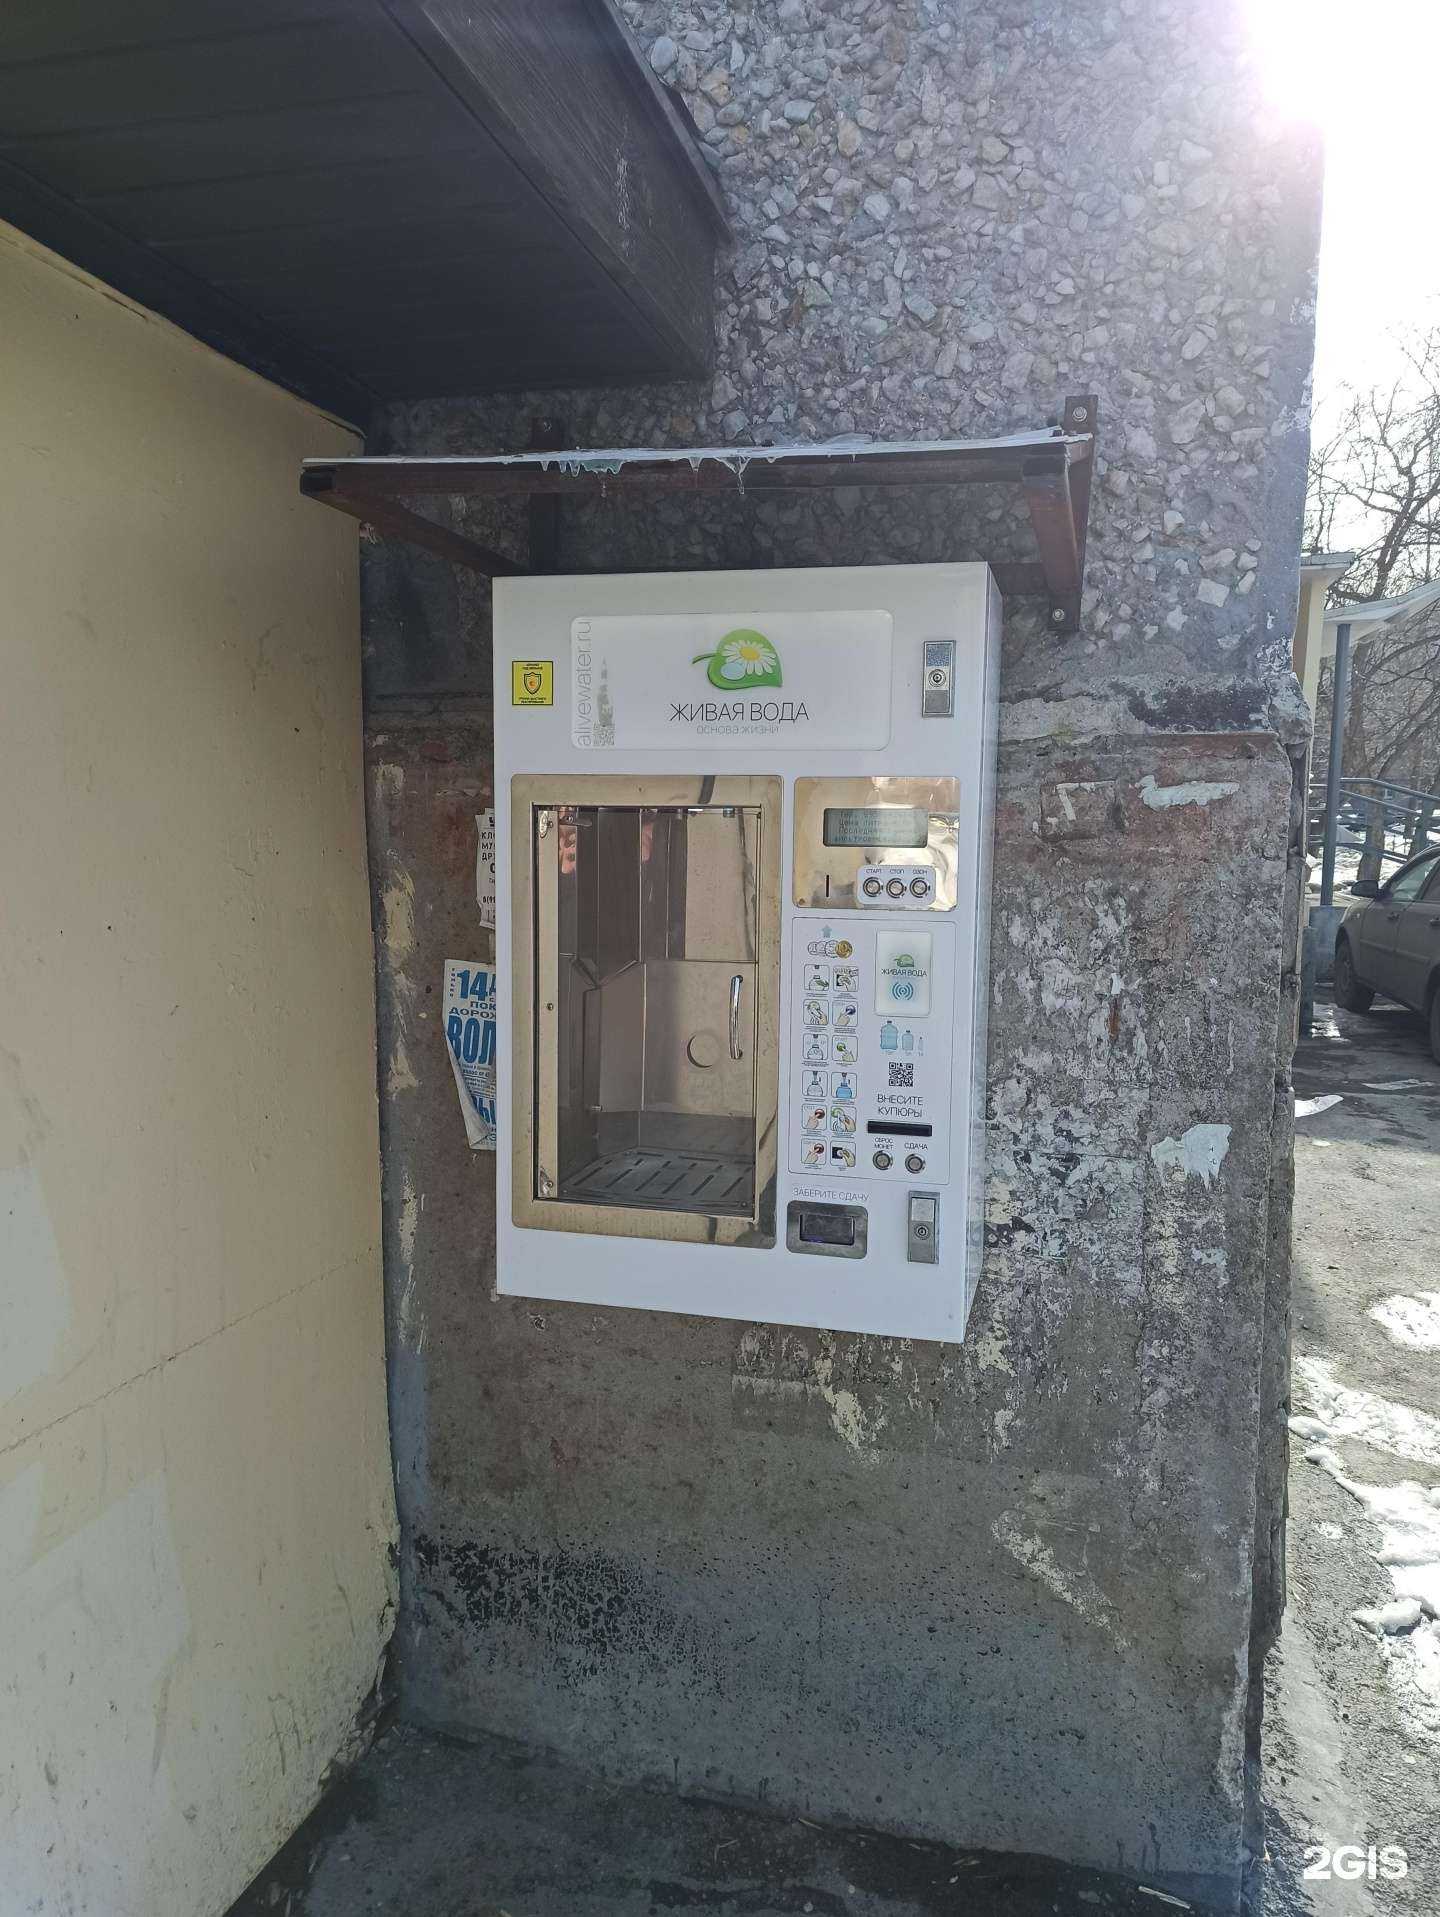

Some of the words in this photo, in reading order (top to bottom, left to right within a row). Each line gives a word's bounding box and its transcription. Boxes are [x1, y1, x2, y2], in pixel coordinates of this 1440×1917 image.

[575, 621, 592, 746] alivewater.ru
[669, 702, 744, 722] ЖИВАЯ
[750, 702, 809, 724] ВОДА
[696, 725, 739, 735] основа
[881, 968, 906, 976] ЖИВАЯ
[907, 969, 928, 977] ВОДА
[877, 1093, 924, 1106] ВНЕСИТЕ
[878, 1106, 922, 1118] КУПЮРЫ
[904, 1142, 928, 1150] СДАЧА
[793, 1187, 837, 1200] ЗАБЕРИТЕ
[838, 1191, 870, 1201] СДАЧУ
